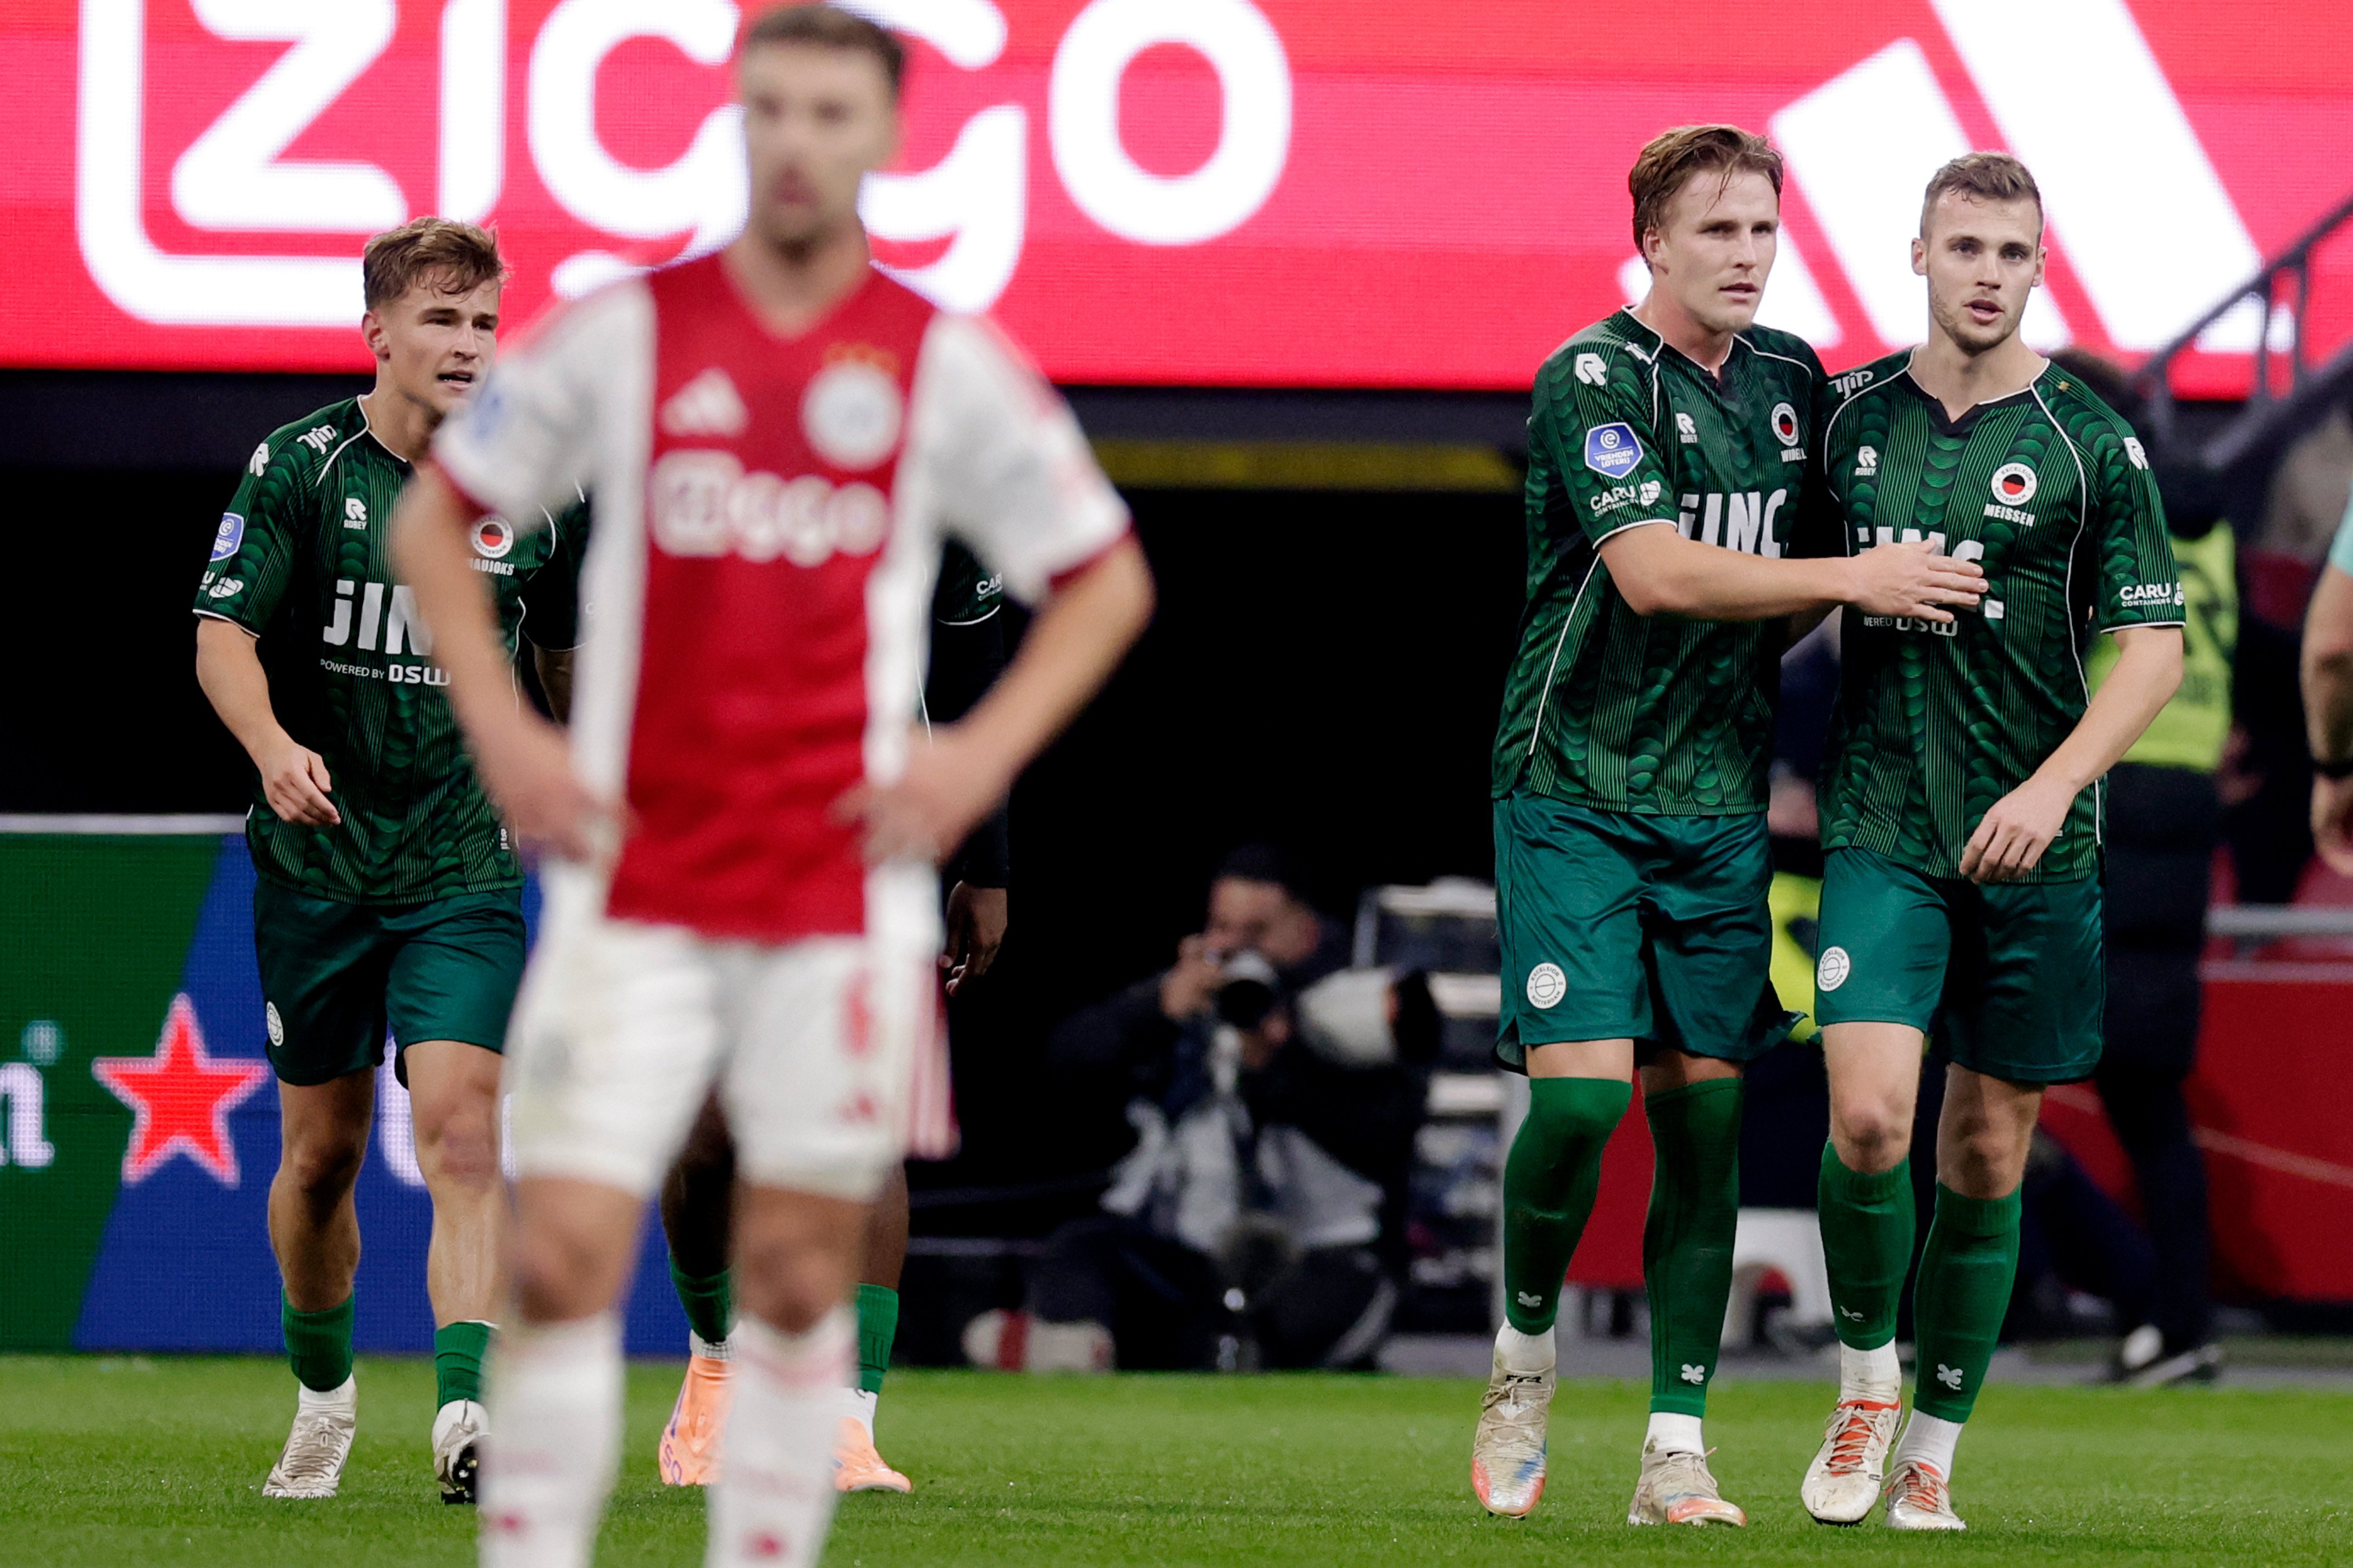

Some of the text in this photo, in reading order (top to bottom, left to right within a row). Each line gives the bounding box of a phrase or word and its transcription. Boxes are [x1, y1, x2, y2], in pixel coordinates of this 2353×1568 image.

[1594, 449, 1634, 462] VRIENDEN
[1590, 485, 1636, 510] CARU
[1984, 503, 2035, 527] MEISSEN
[2119, 582, 2172, 600] CARU
[2122, 597, 2172, 607] CONTAINERS
[372, 669, 385, 680] BY
[388, 664, 452, 686] DSW
